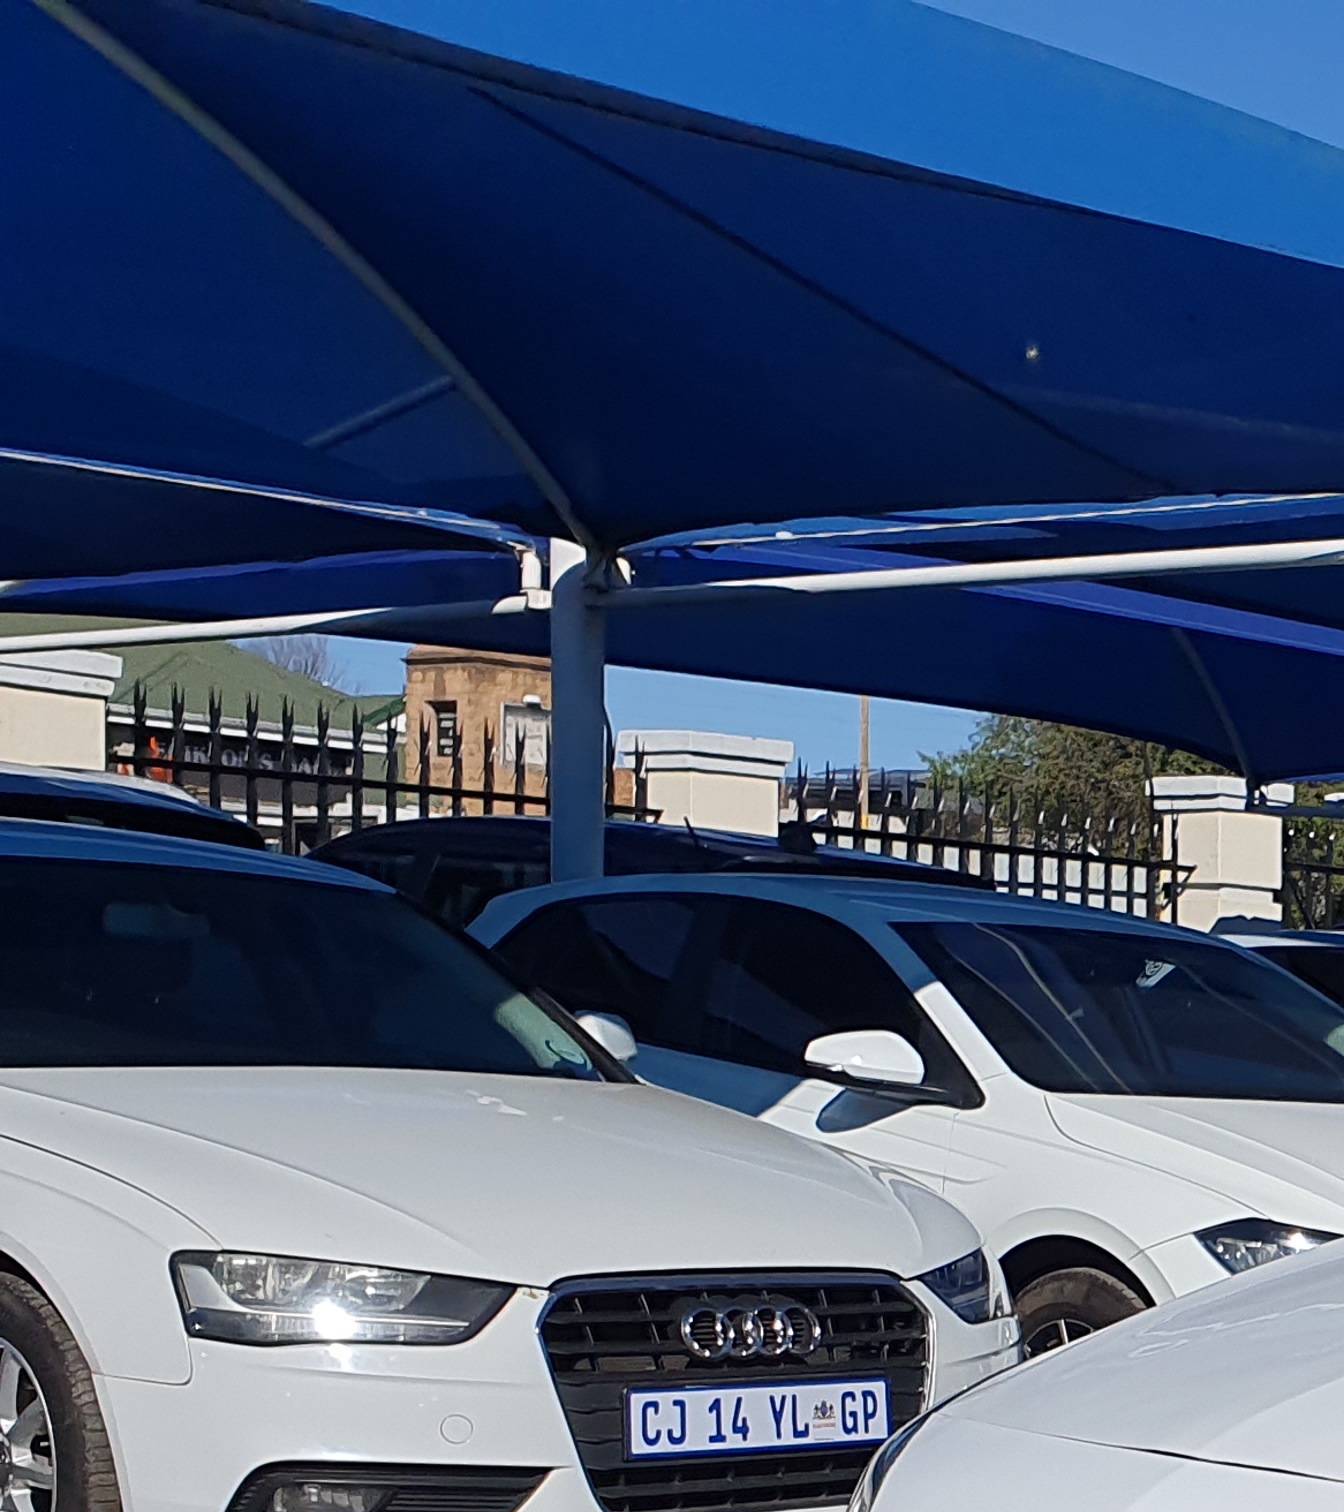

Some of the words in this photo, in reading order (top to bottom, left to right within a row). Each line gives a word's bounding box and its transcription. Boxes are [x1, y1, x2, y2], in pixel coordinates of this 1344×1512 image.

[641, 1399, 687, 1447] CJ
[708, 1397, 750, 1444] 14
[769, 1394, 810, 1440] YL
[840, 1390, 879, 1436] GP
